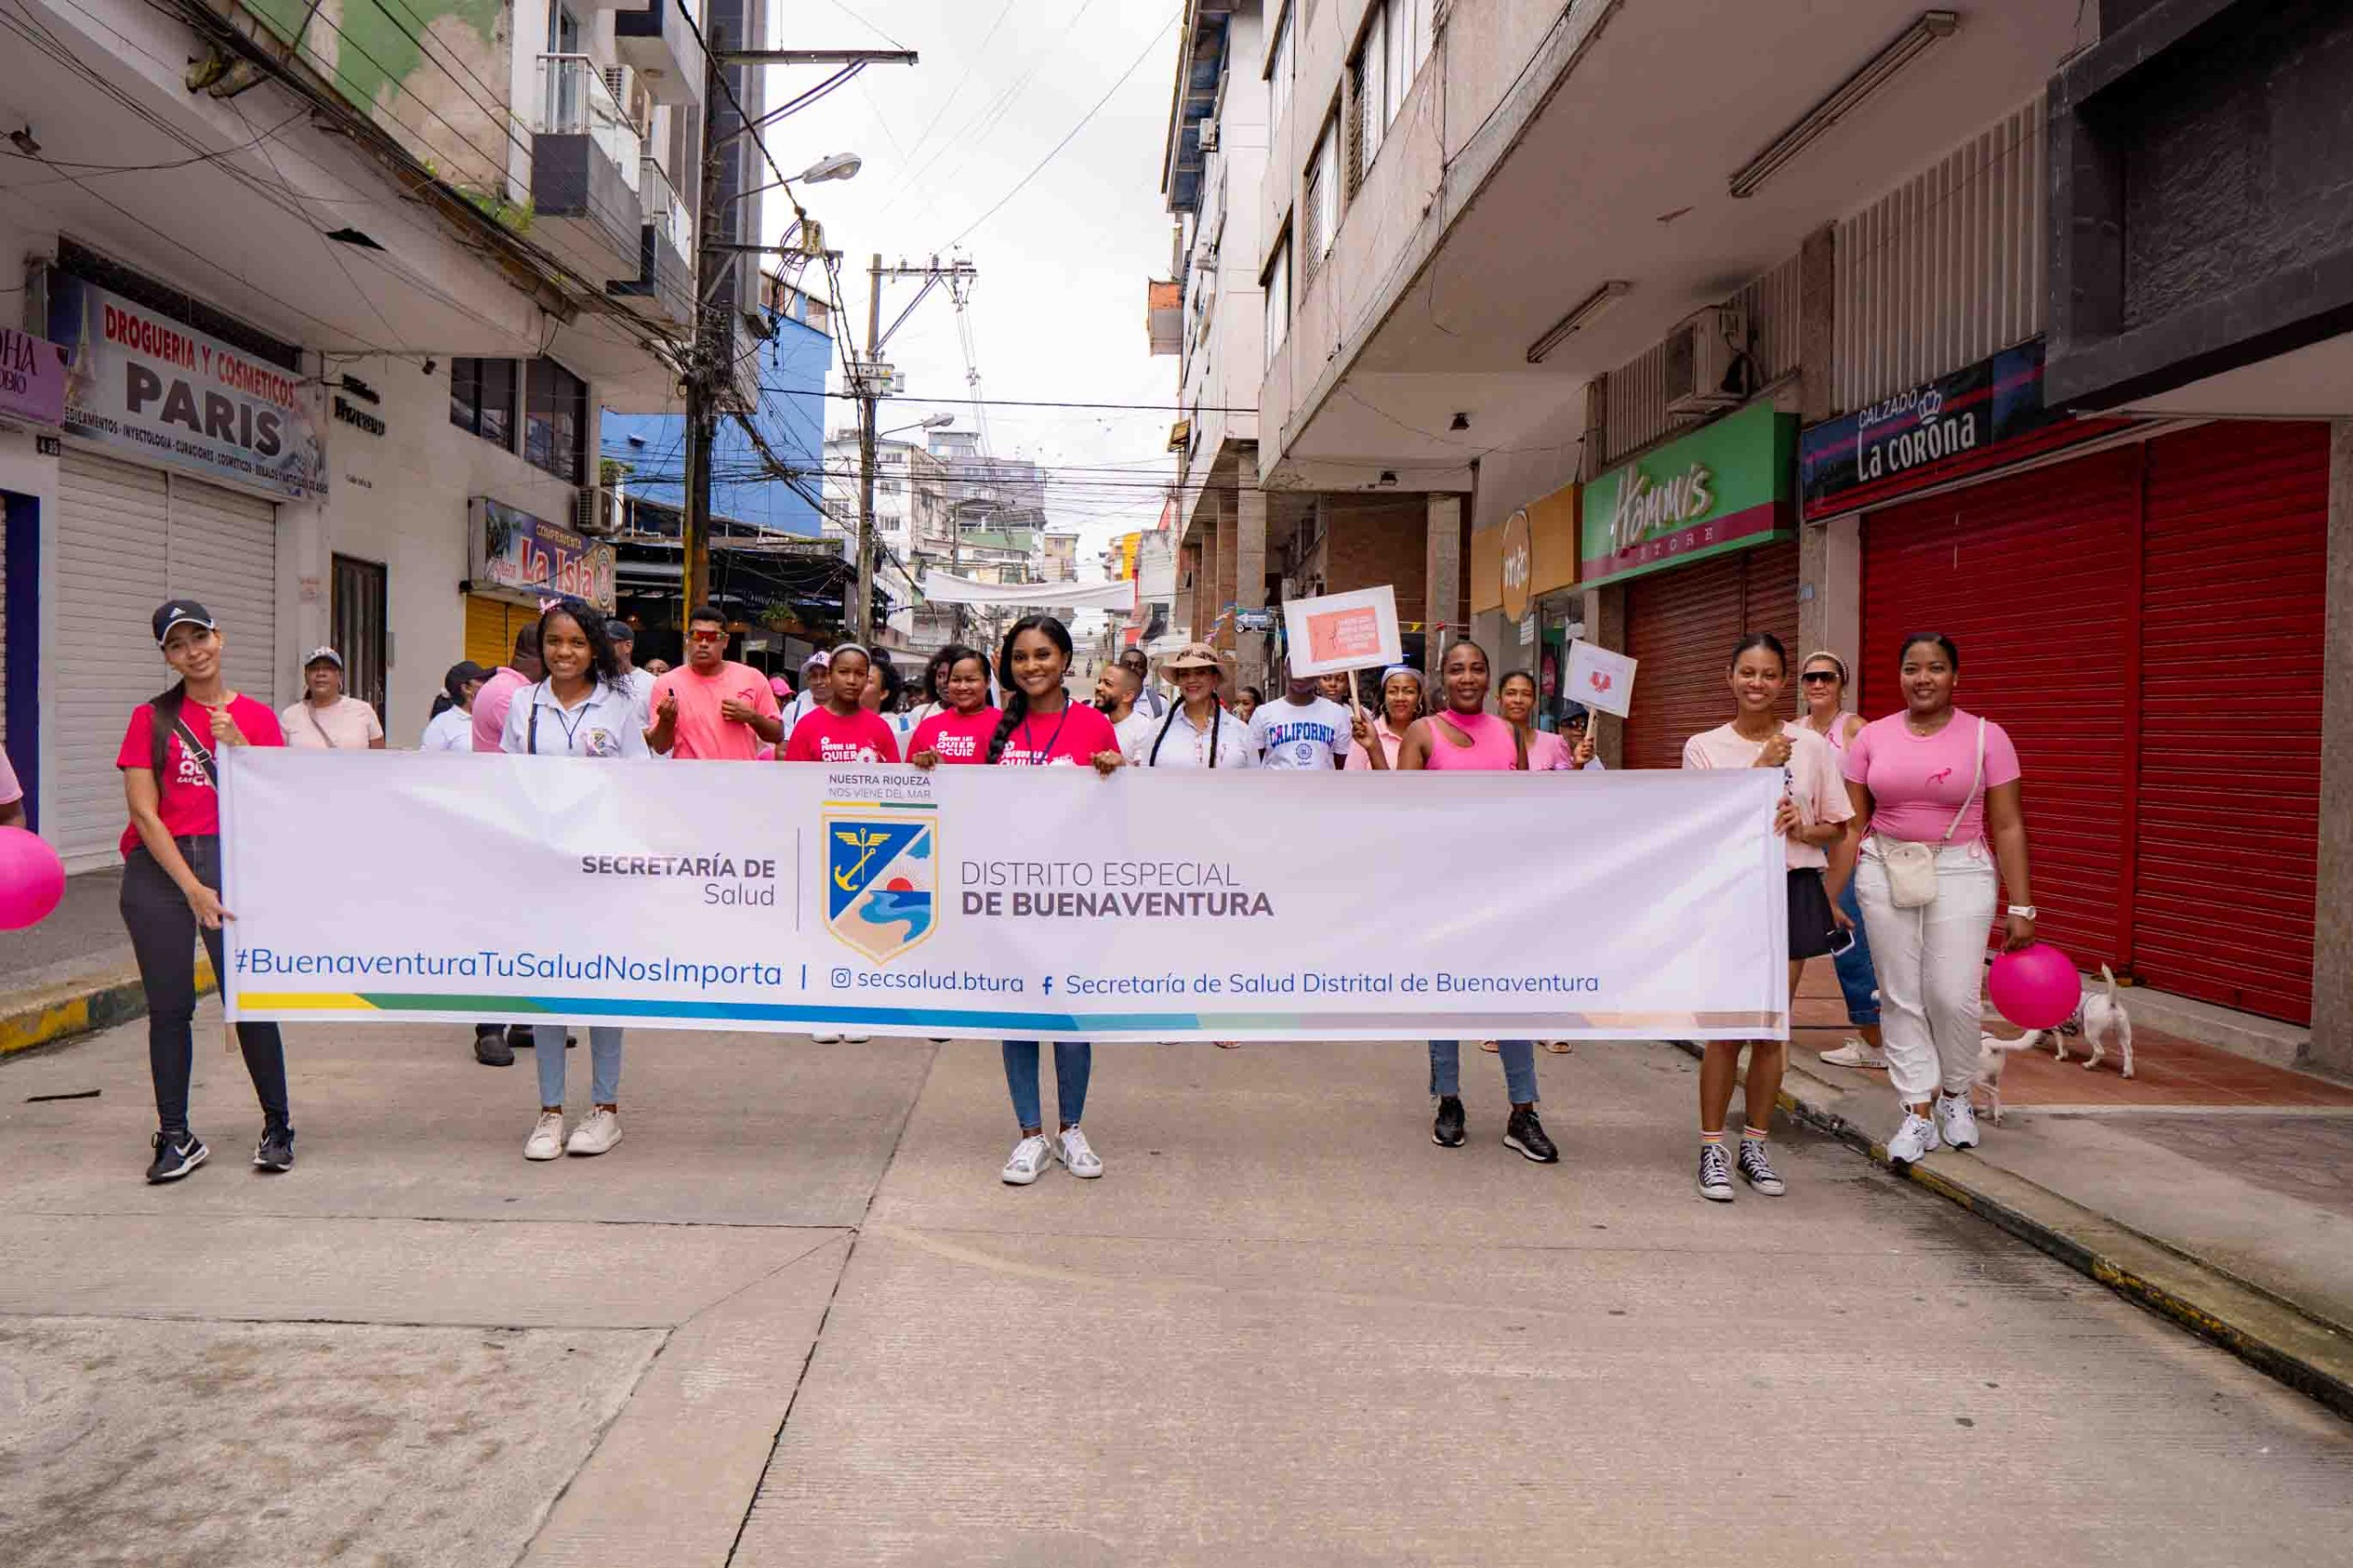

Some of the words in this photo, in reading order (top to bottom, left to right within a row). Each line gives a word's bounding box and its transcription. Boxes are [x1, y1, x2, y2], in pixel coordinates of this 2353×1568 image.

[0, 329, 37, 376] HA
[103, 303, 197, 371] DROGUERIA
[201, 345, 211, 375] Y
[217, 352, 294, 410] COSMETICOS
[64, 405, 118, 434] EDICAMENTOS
[126, 361, 281, 457] PARIS
[1859, 389, 1917, 428] CALZADO
[1857, 428, 1881, 483] La
[520, 536, 551, 590] La
[554, 547, 594, 598] Isla
[822, 750, 858, 762] QUIER
[828, 774, 880, 785] NUESTRA
[882, 776, 930, 786] RIQUEZA
[829, 788, 852, 797] NOS
[855, 789, 882, 798] VIENE
[885, 789, 904, 799] DEL
[907, 790, 931, 799] MAR
[582, 853, 736, 878] SECRETARÍA
[745, 859, 775, 878] DE
[961, 861, 1093, 886] DISTRITO
[1103, 862, 1240, 886] ESPECIAL
[704, 882, 774, 906] Salud
[962, 892, 1002, 915] DE
[1012, 892, 1274, 917] BUENAVENTURA
[235, 949, 781, 990] #BuenaventuraTuSaludNosImporta
[858, 969, 1024, 993] secsalud.btura
[1066, 972, 1186, 994] Secretaría
[1193, 973, 1222, 994] de
[1230, 973, 1294, 994] Salud
[1303, 972, 1392, 993] Distrital
[1401, 972, 1428, 993] de
[1437, 972, 1599, 993] Buenaventura
